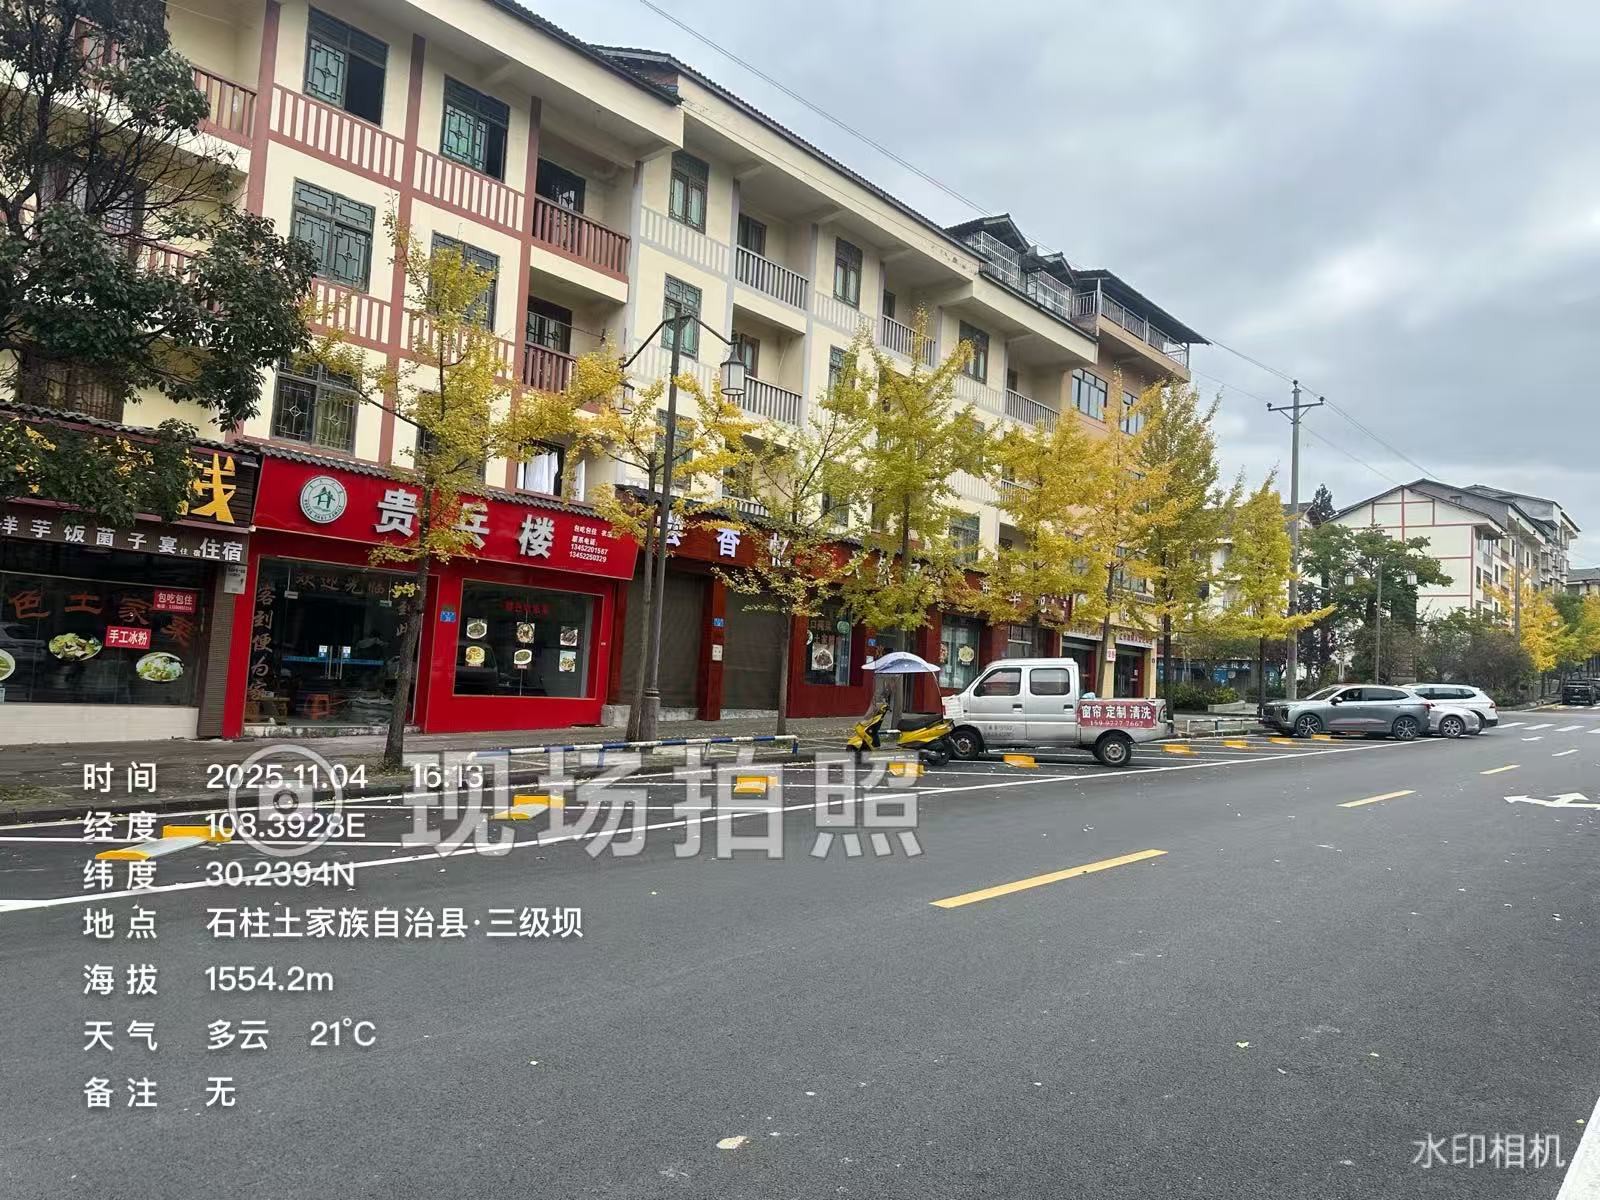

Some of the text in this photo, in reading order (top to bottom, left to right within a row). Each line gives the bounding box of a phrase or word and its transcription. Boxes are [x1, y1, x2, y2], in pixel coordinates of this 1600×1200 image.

[200, 536, 243, 562] 住宿
[158, 592, 193, 605] 包吃包住
[109, 629, 148, 645] 手工冰粉
[1081, 704, 1152, 720] 窗帘 定制 清洗
